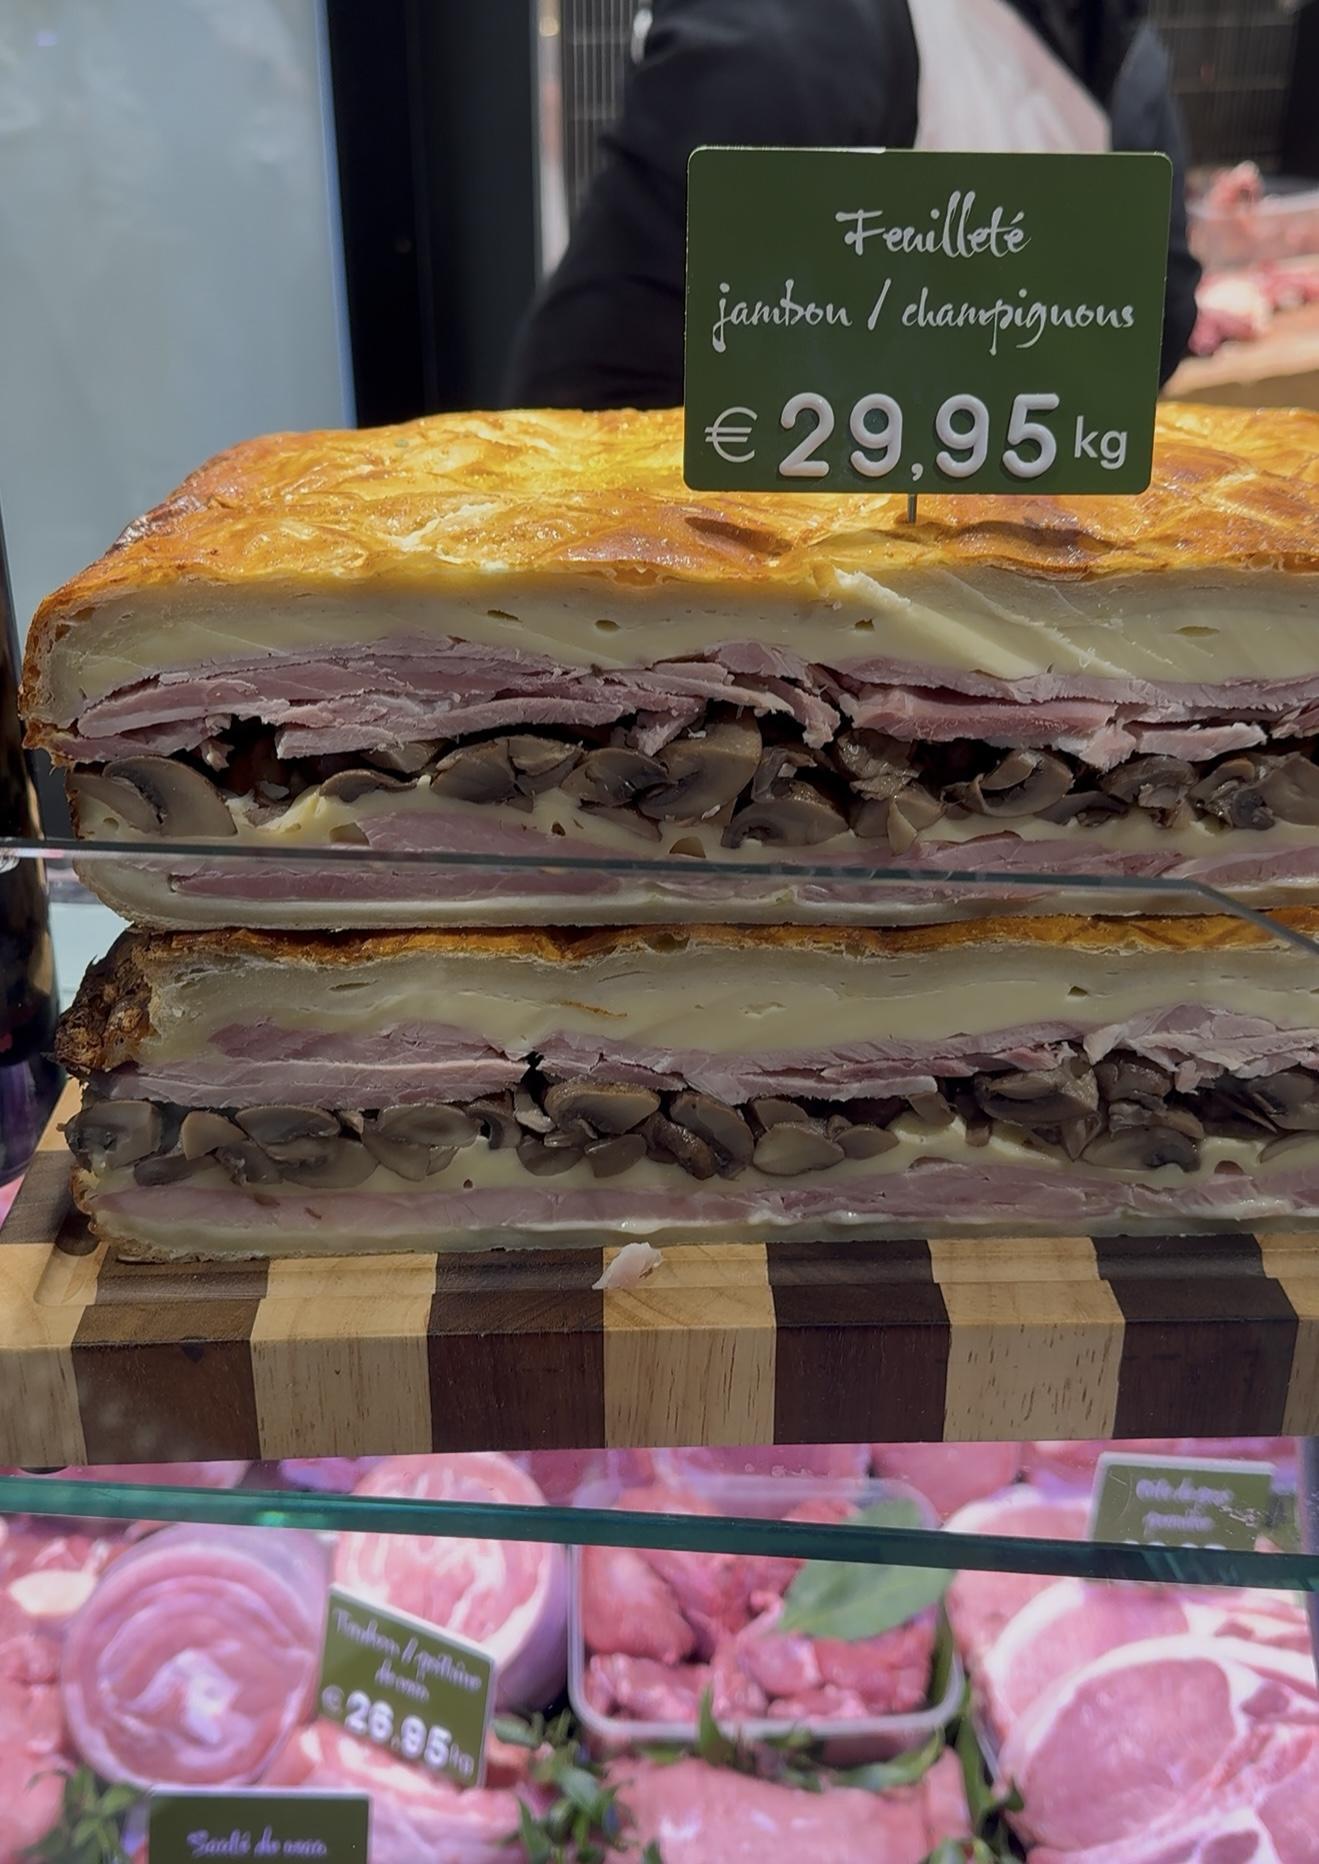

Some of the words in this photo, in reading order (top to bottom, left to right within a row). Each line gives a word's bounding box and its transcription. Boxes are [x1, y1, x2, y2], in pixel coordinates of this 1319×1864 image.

[835, 190, 1031, 257] Feuilleté
[713, 280, 852, 352] jambon
[868, 279, 891, 330] /
[902, 287, 1134, 355] champignons
[705, 407, 757, 462] €
[779, 392, 1060, 481] 29,95
[1075, 416, 1127, 469] kg
